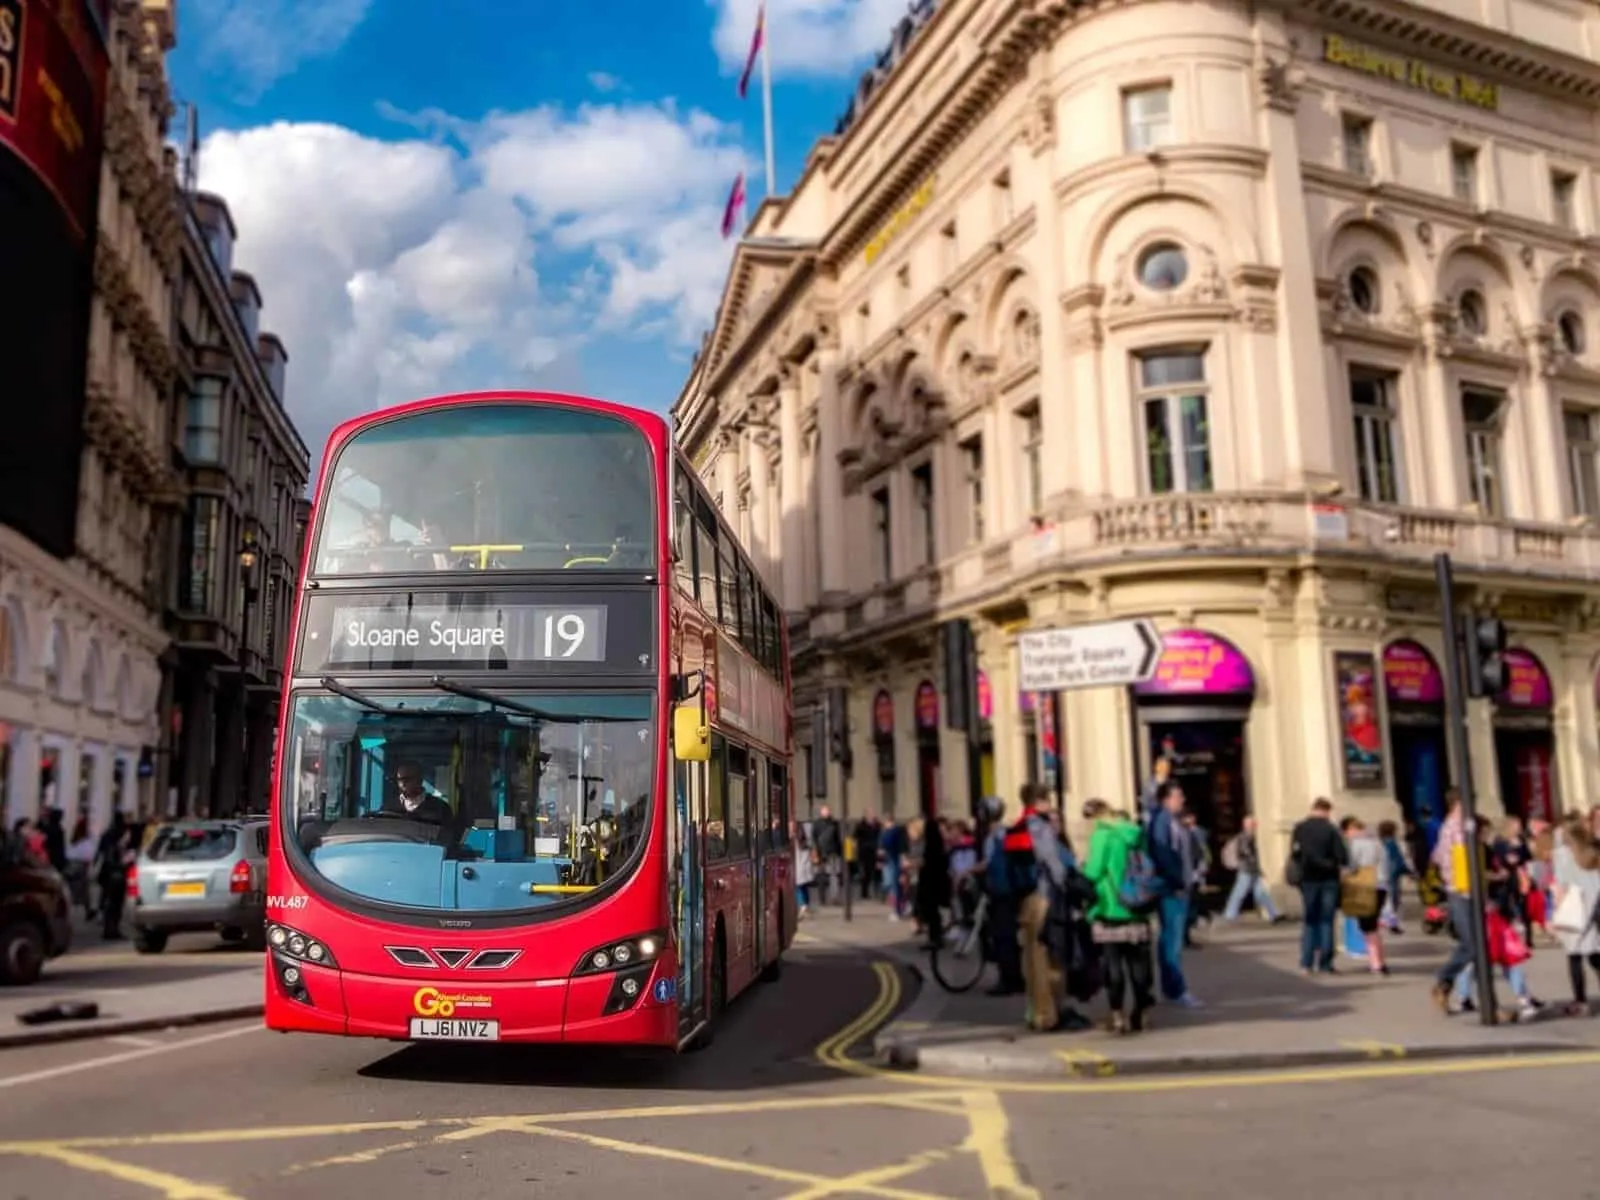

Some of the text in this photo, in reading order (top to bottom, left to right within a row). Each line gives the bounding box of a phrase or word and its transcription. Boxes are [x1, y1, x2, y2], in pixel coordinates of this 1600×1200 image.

[347, 620, 505, 653] Sloane Square
[544, 614, 585, 657] 19
[413, 986, 454, 1016] Go
[420, 1019, 489, 1038] LJ61 NVZ
